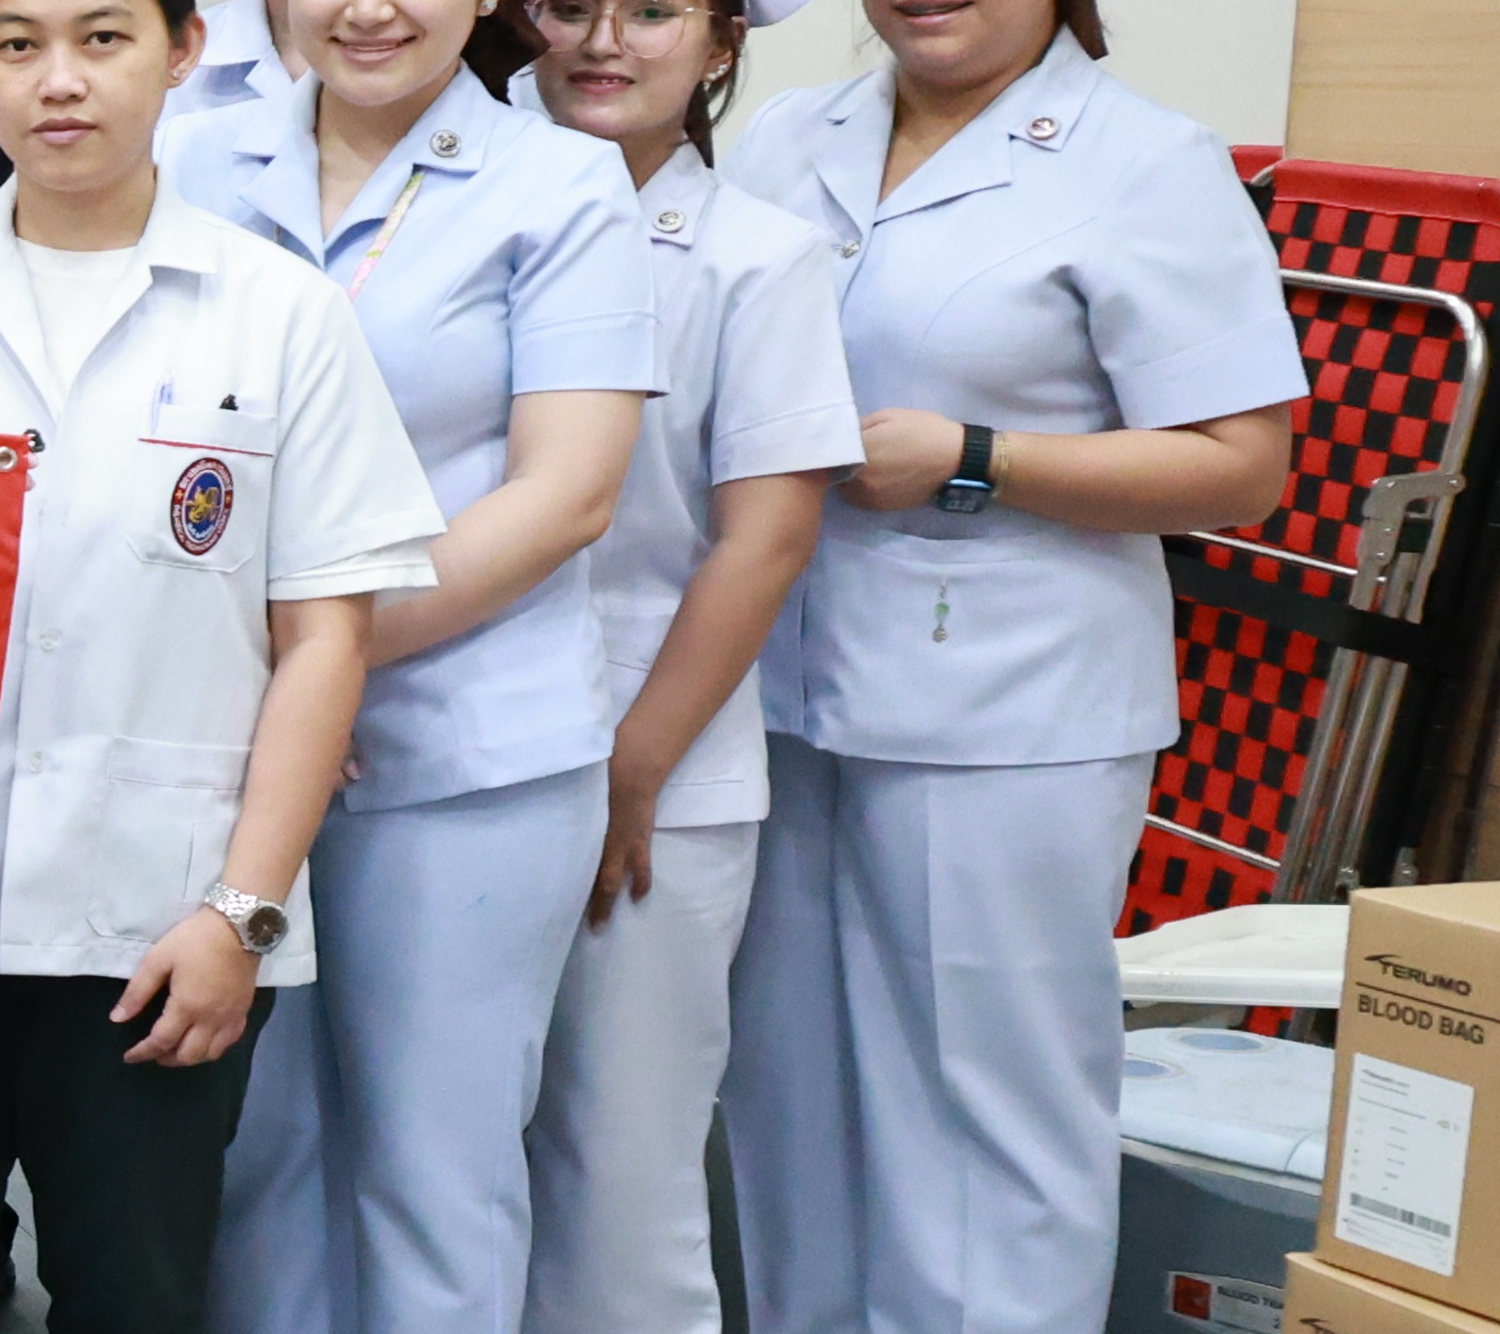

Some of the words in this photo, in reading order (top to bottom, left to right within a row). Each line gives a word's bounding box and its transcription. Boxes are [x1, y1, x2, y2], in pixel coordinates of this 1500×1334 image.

[1364, 954, 1472, 996] TERUMO
[1357, 994, 1434, 1030] BLOOD
[1439, 1014, 1485, 1045] BAG
